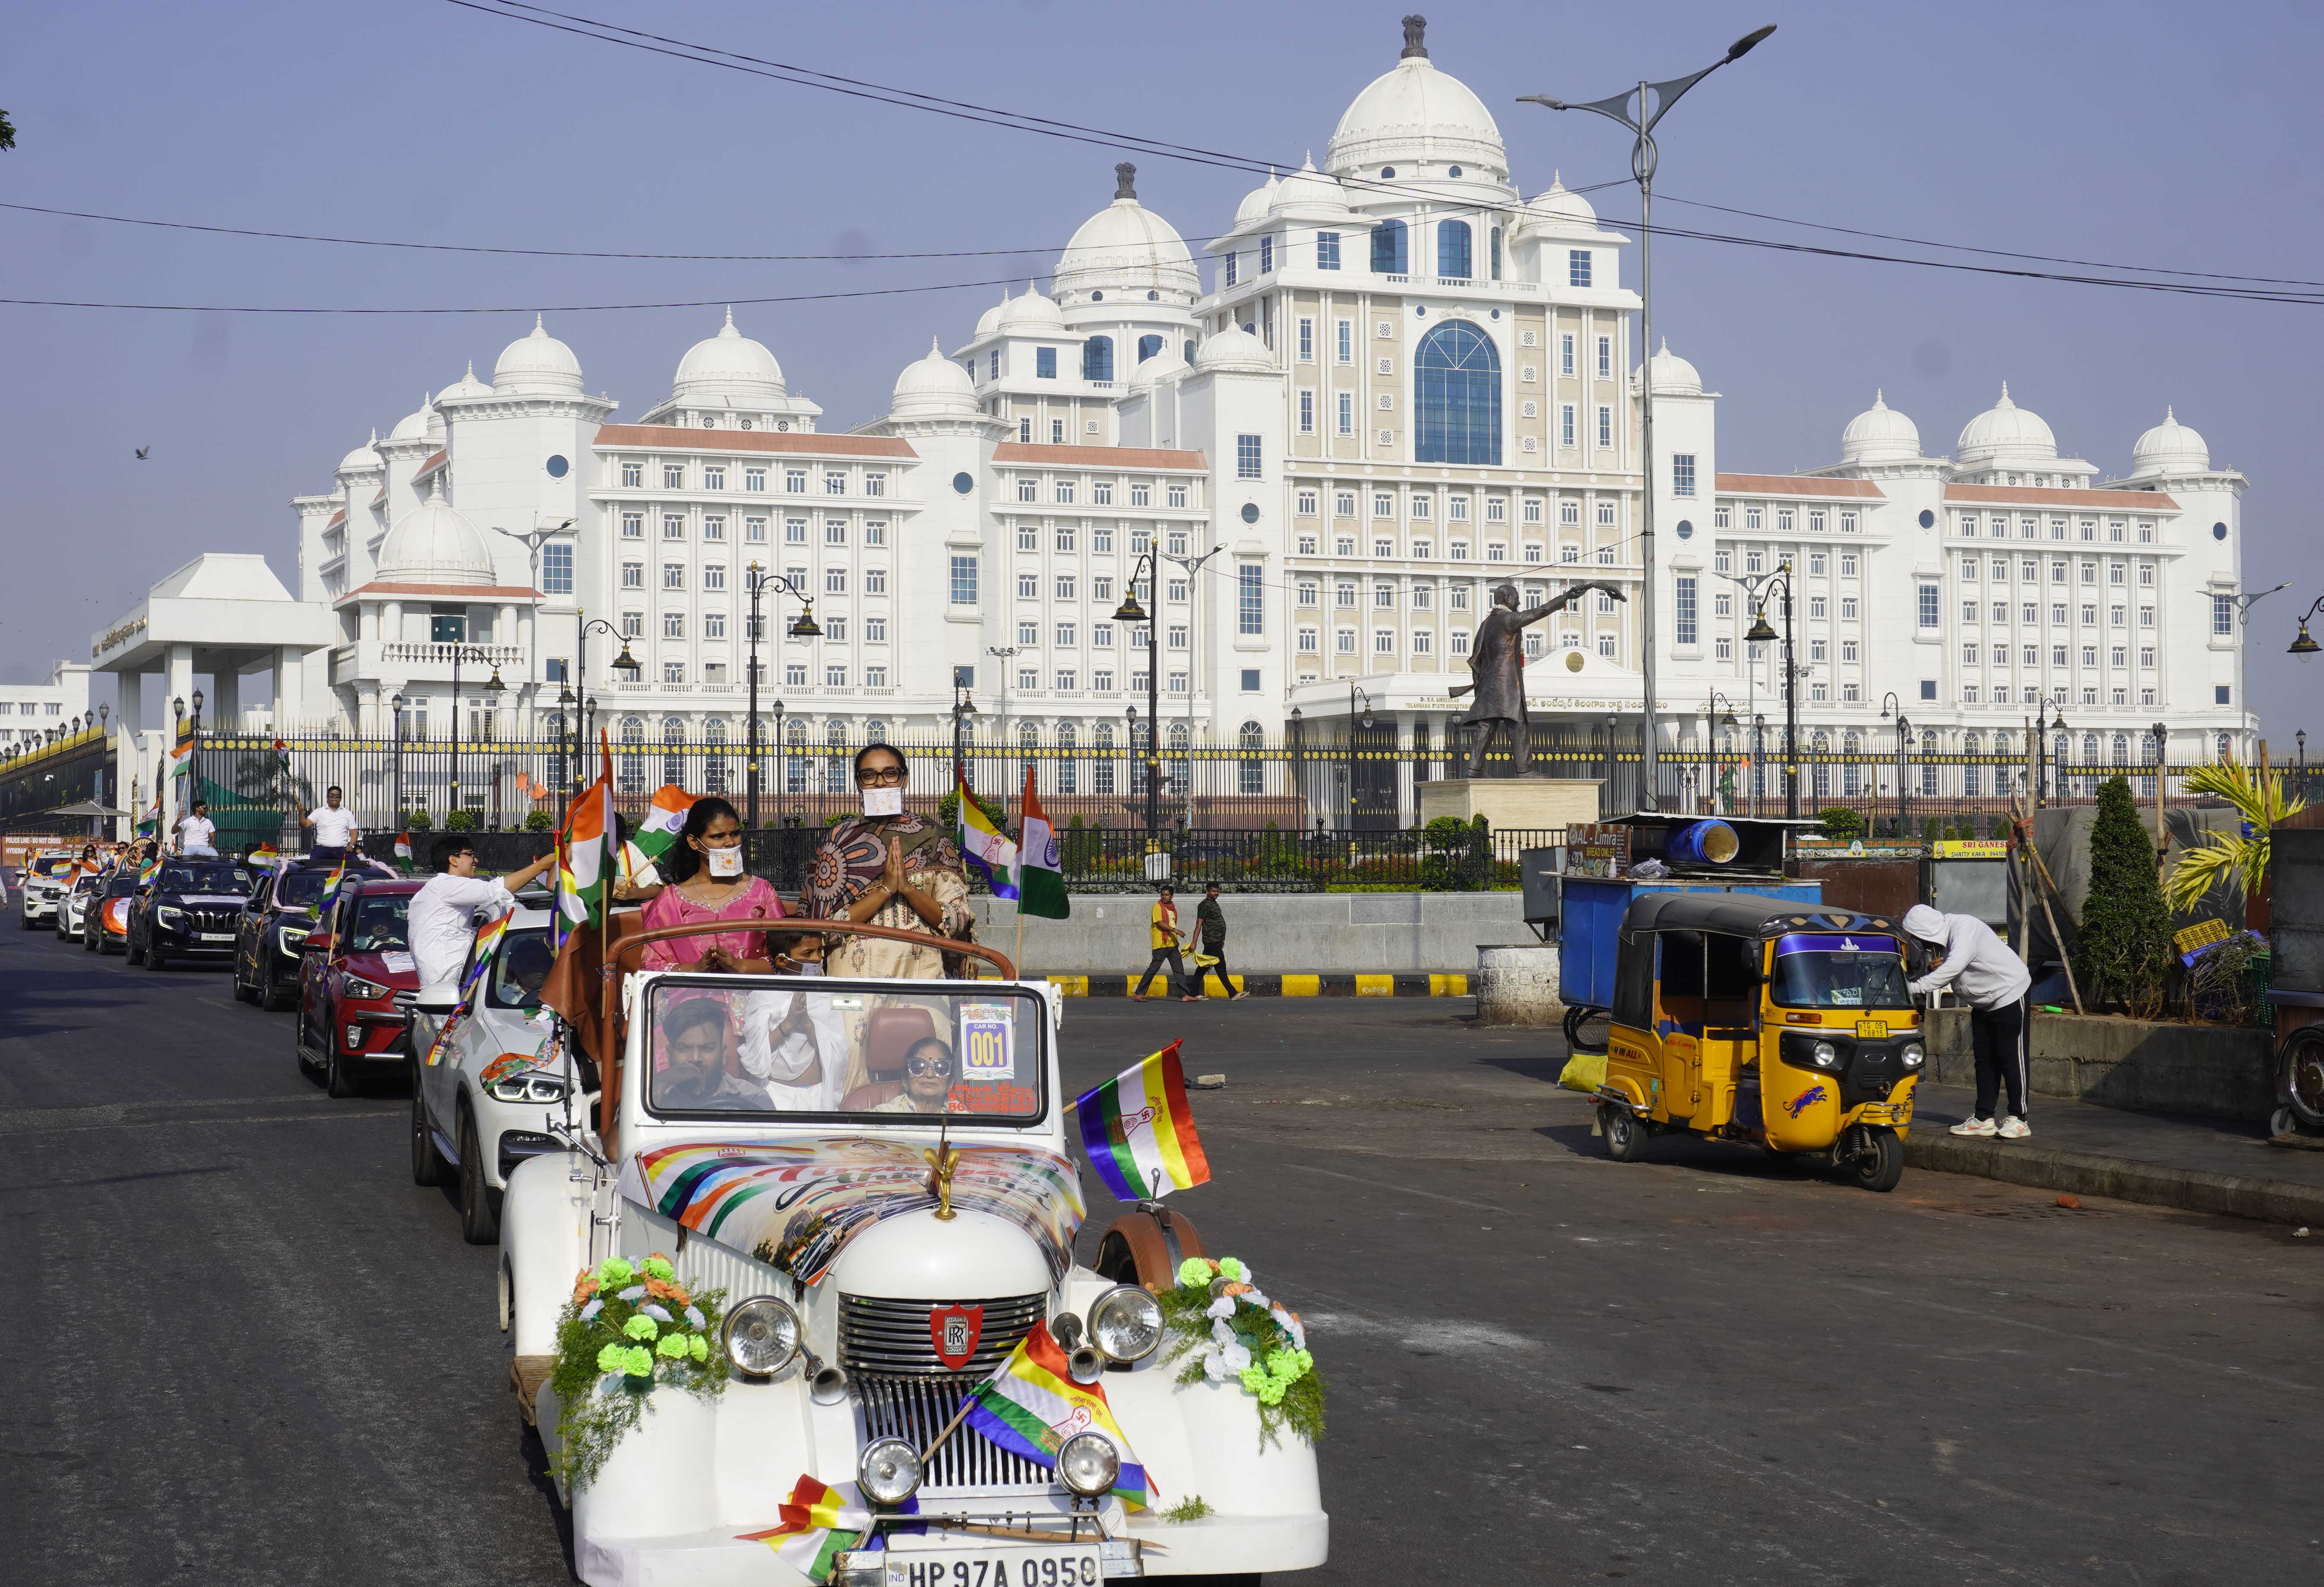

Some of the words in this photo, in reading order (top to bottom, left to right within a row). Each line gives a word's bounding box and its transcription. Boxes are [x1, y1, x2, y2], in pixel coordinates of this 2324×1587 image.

[1625, 701, 1667, 709] సచివాయం
[1594, 830, 1616, 845] Limra
[1587, 847, 1599, 857] BREAD
[1601, 848, 1615, 857] OMLET
[970, 1031, 1003, 1067] 001
[1619, 1047, 1626, 1056] IN
[1626, 1050, 1638, 1059] ALL
[845, 1180, 894, 1189] CAR
[889, 1574, 904, 1582] IND
[910, 1562, 945, 1587] HP
[954, 1560, 1008, 1587] 97A
[1022, 1556, 1096, 1587] 0958
